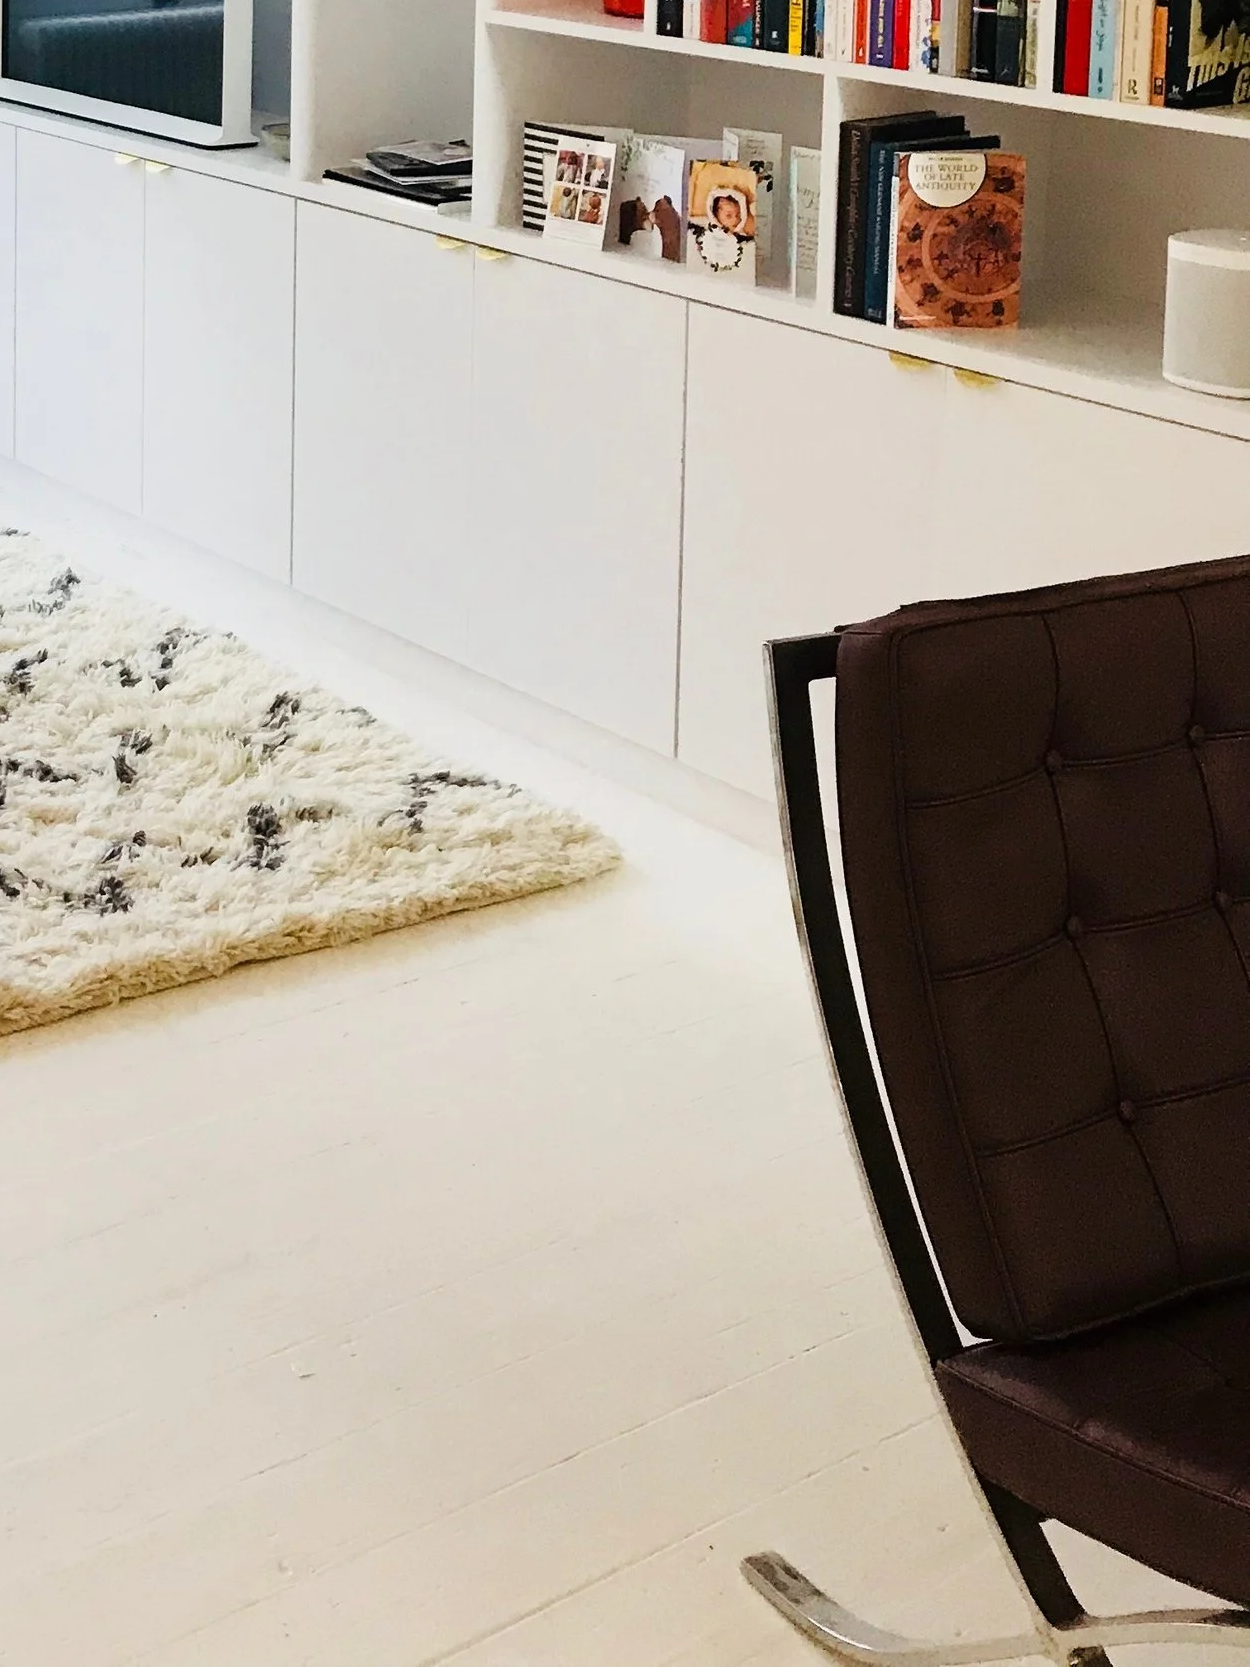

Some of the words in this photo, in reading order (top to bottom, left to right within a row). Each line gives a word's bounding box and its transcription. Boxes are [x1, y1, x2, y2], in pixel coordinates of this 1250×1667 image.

[754, 0, 762, 35] SALINGER
[915, 164, 936, 173] THE
[937, 164, 979, 174] WORLD
[939, 172, 965, 181] LATE
[915, 181, 978, 191] ANTIQUITY
